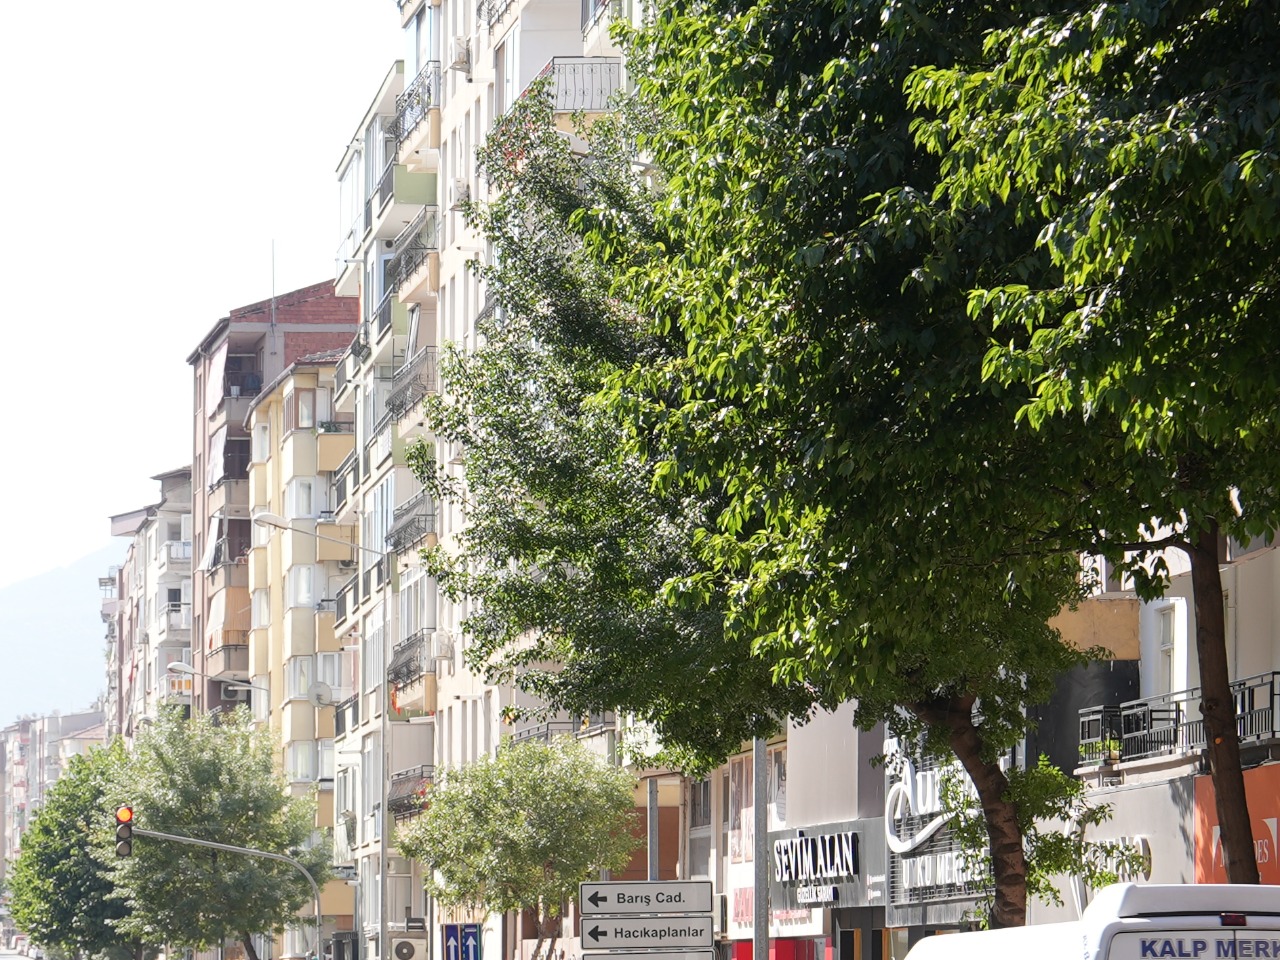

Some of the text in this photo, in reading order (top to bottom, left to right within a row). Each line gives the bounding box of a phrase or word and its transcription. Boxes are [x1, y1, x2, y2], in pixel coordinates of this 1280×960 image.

[774, 829, 854, 882] SEVİM ALAN
[617, 892, 685, 906] Barış Cad.
[614, 927, 705, 940] Hacıkaplanlar
[1140, 939, 1207, 958] KALP
